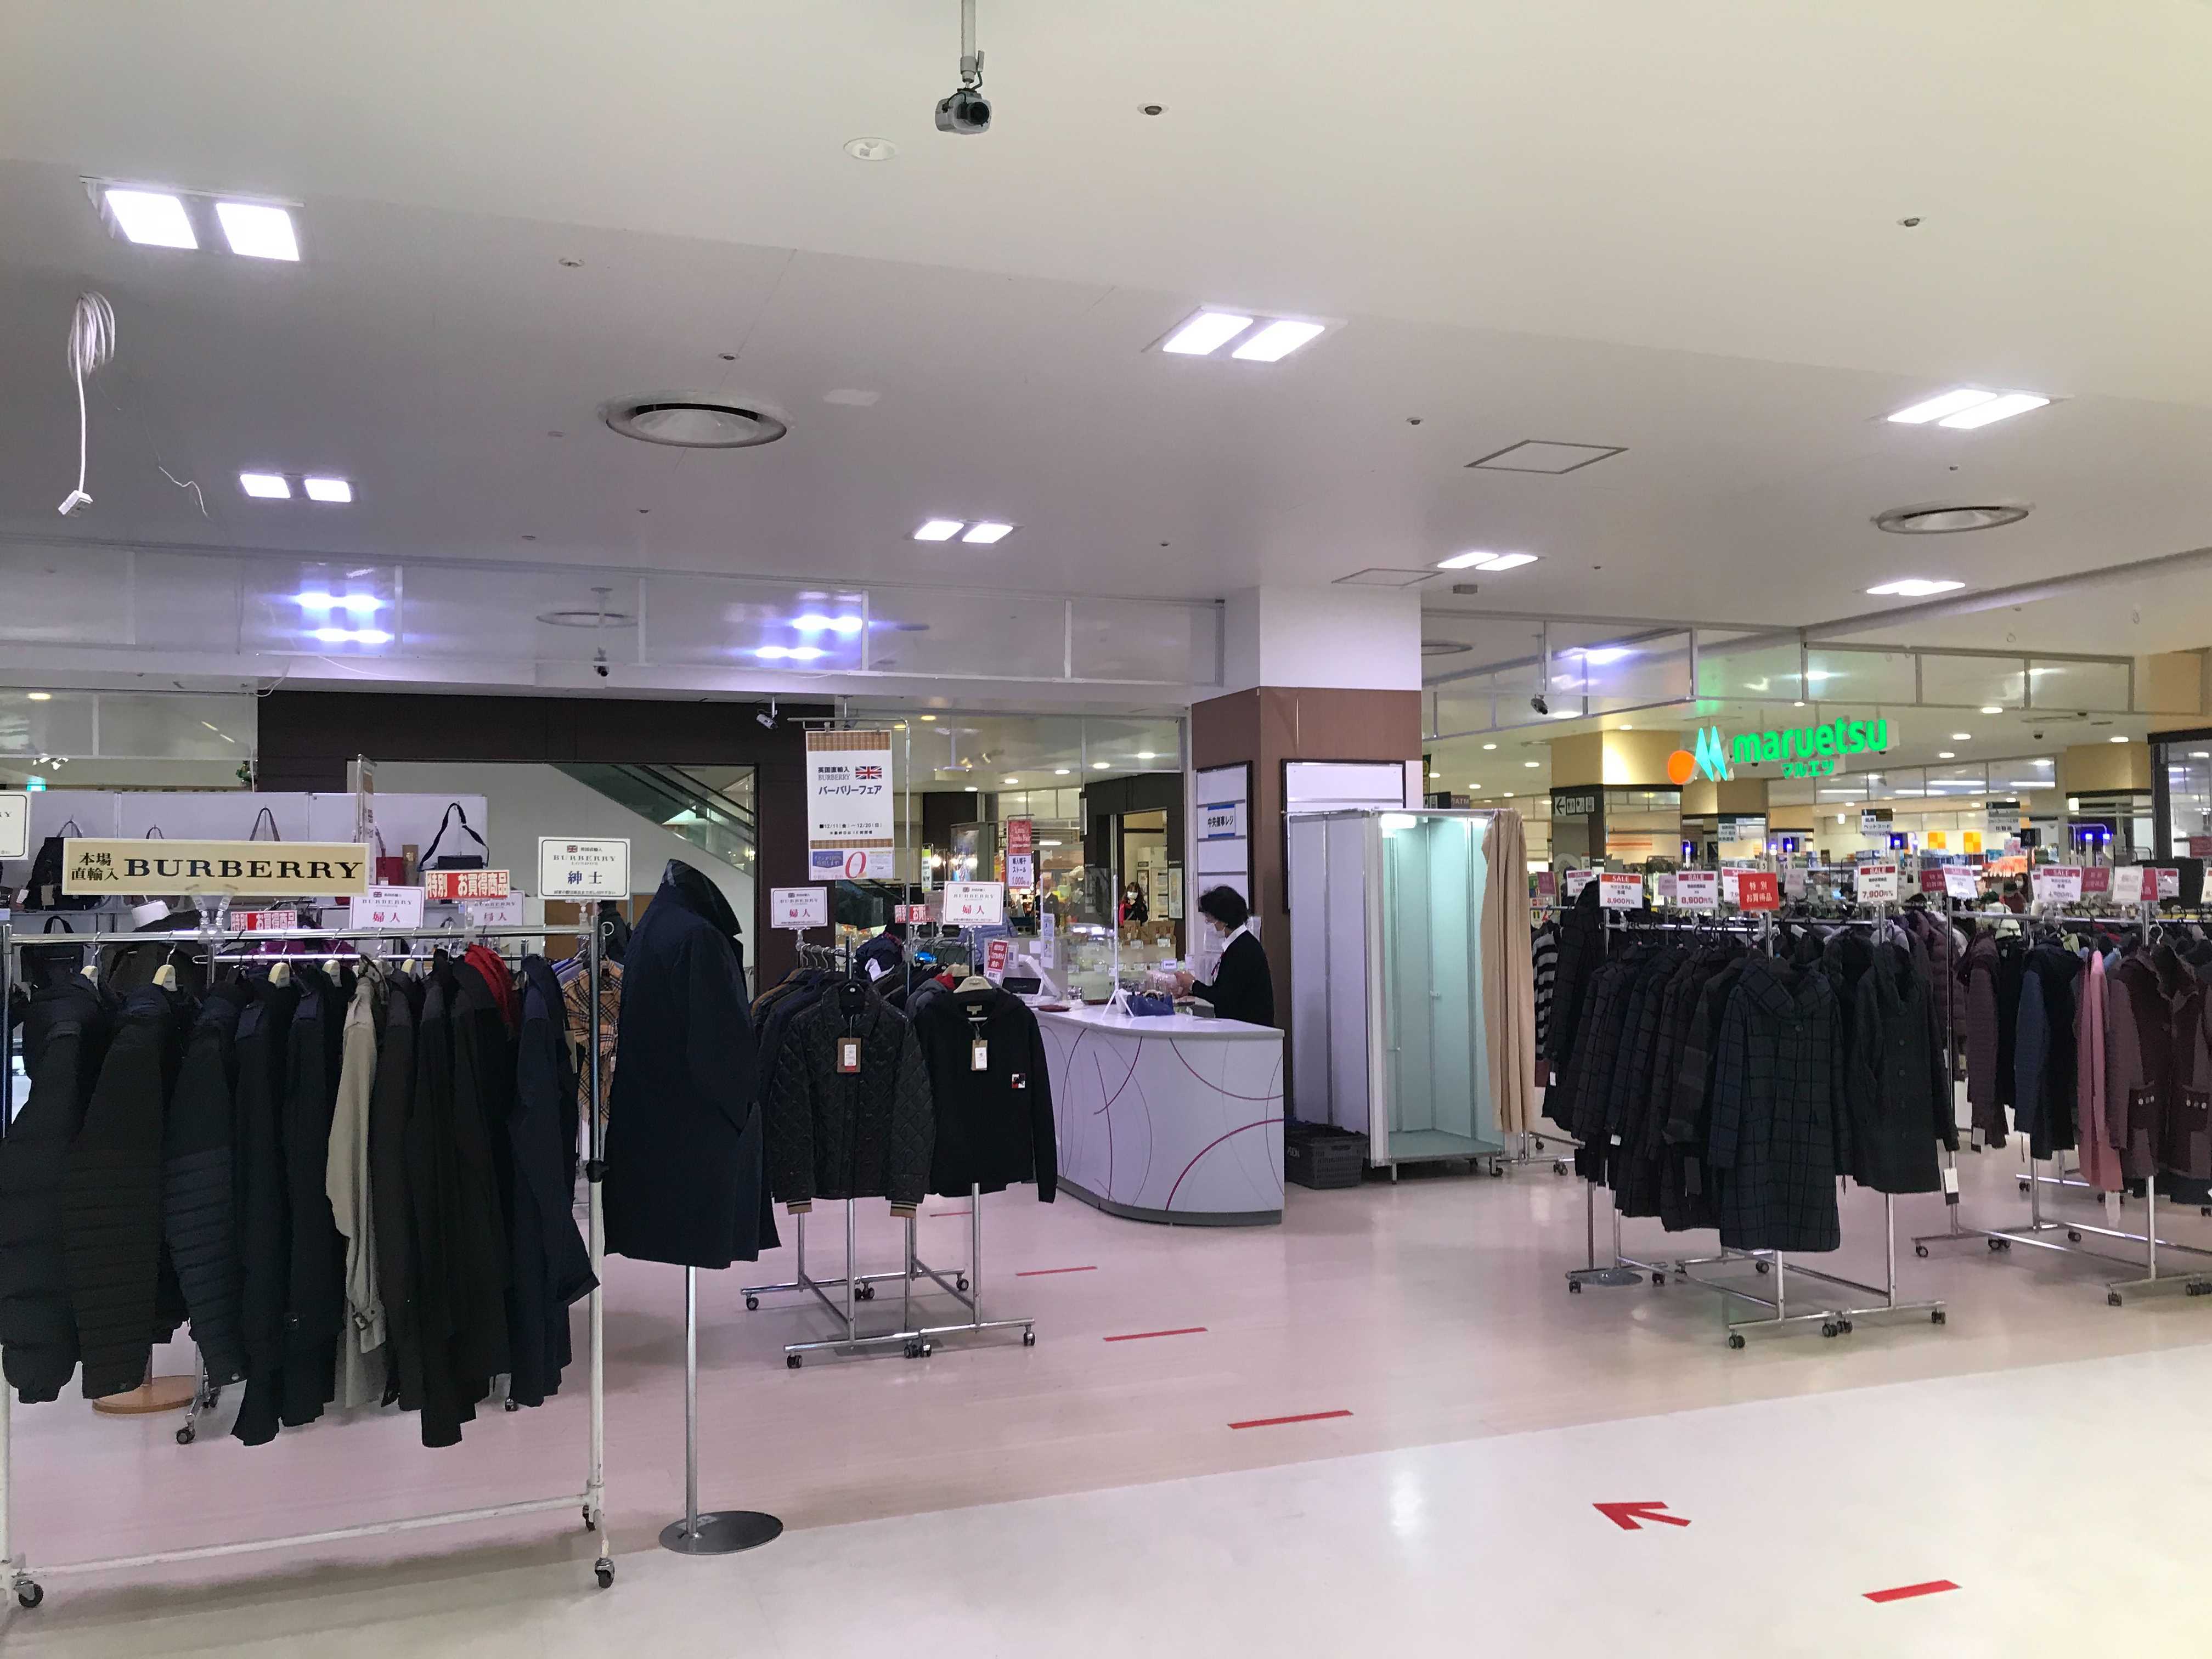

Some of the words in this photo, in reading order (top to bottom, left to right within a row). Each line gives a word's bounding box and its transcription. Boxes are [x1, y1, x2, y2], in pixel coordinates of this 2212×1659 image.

[1734, 717, 1887, 763] maruetsu
[1782, 759, 1834, 778] マルエツ
[819, 785, 882, 795] バーバリーフェア
[80, 853, 112, 866] 本場
[124, 859, 363, 879] BURBERRY
[72, 867, 119, 881] 直輸入
[428, 873, 448, 898] 特別
